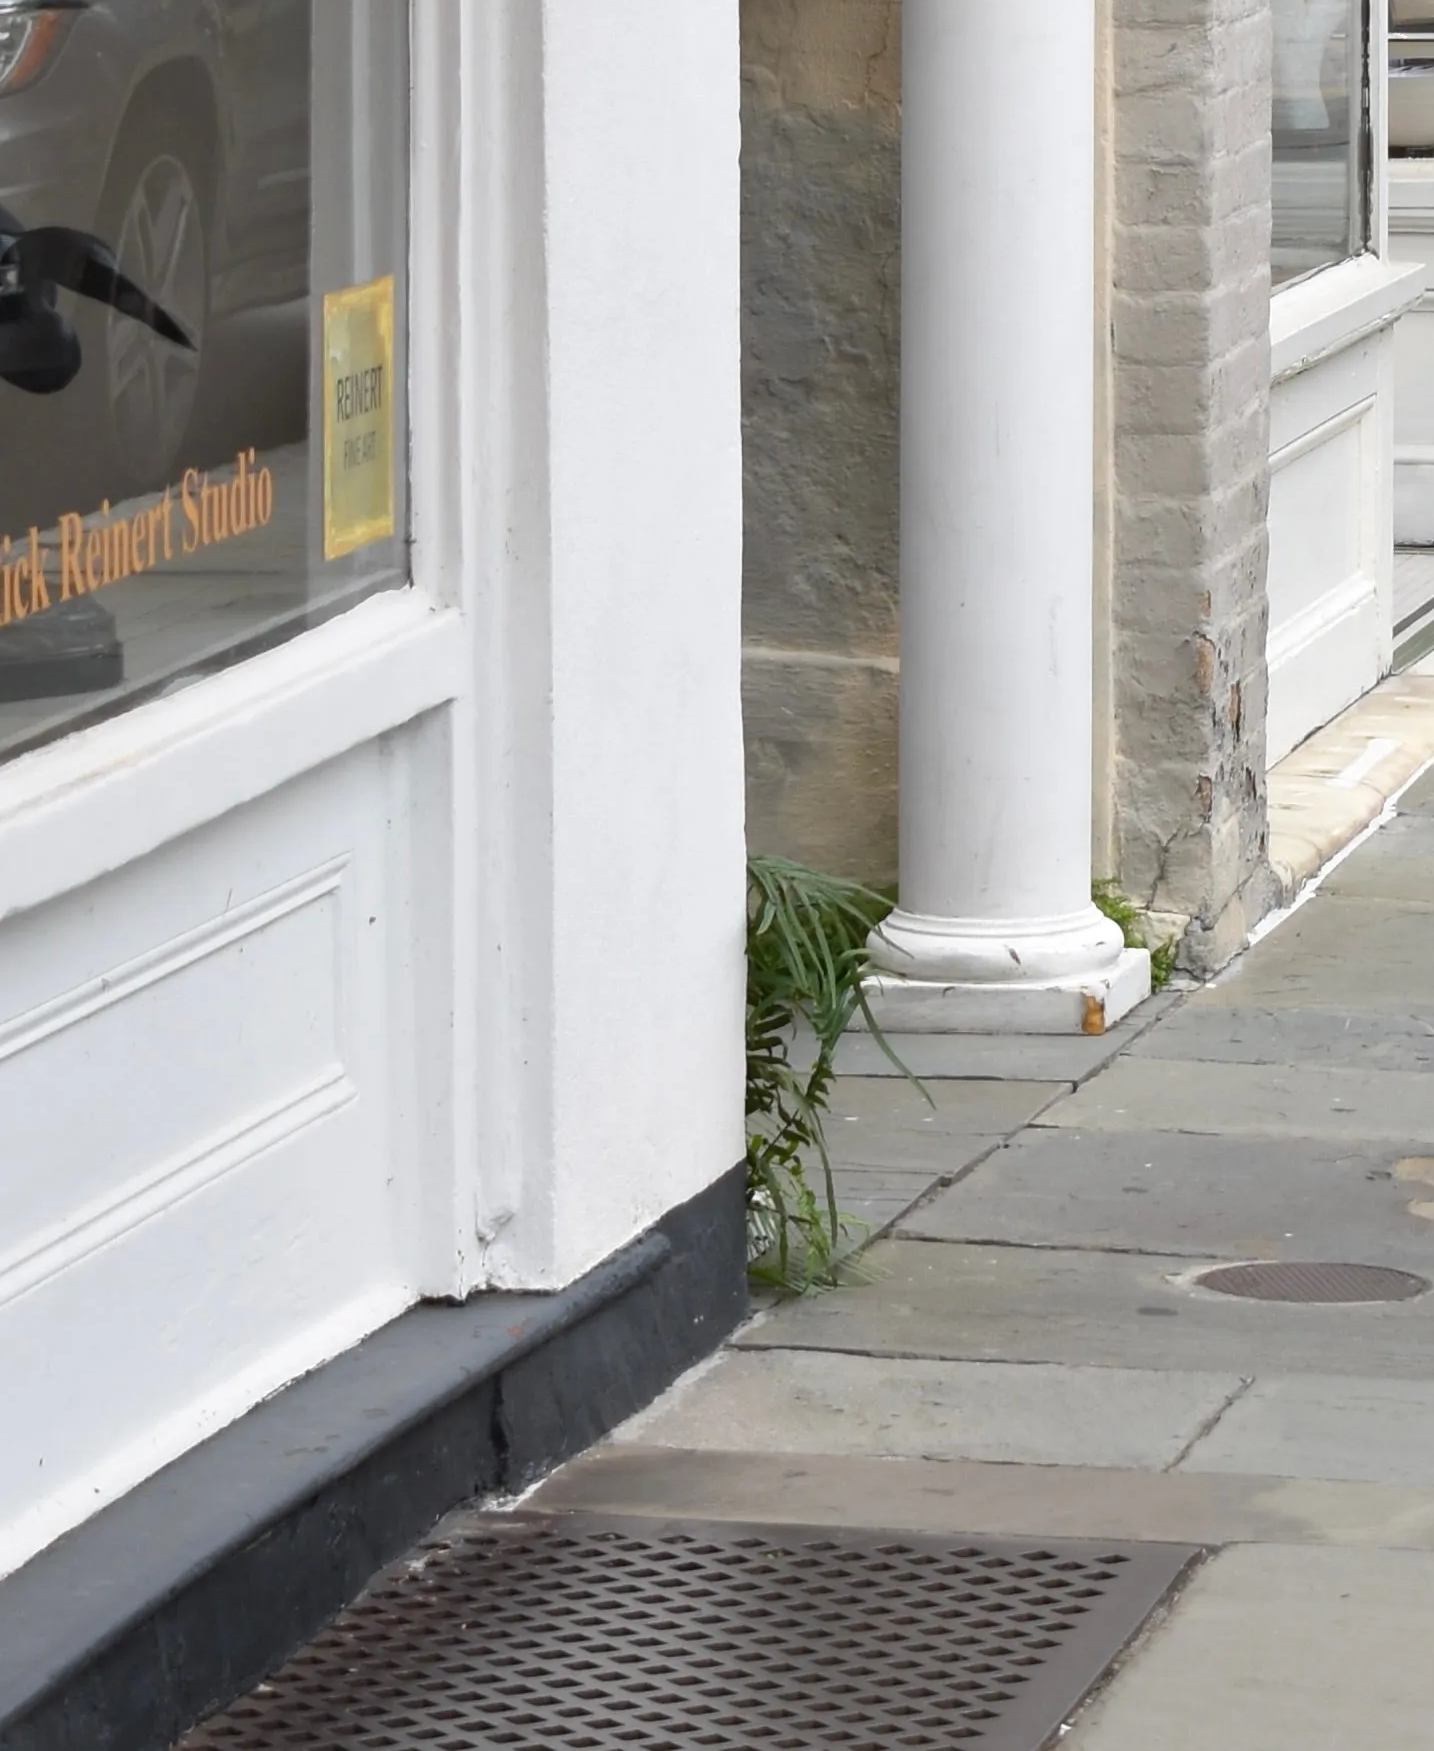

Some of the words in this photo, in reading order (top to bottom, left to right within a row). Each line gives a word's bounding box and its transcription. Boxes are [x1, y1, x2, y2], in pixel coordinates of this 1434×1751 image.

[336, 362, 384, 424] REINERT
[59, 498, 173, 601] Reinert
[181, 446, 272, 554] Studio
